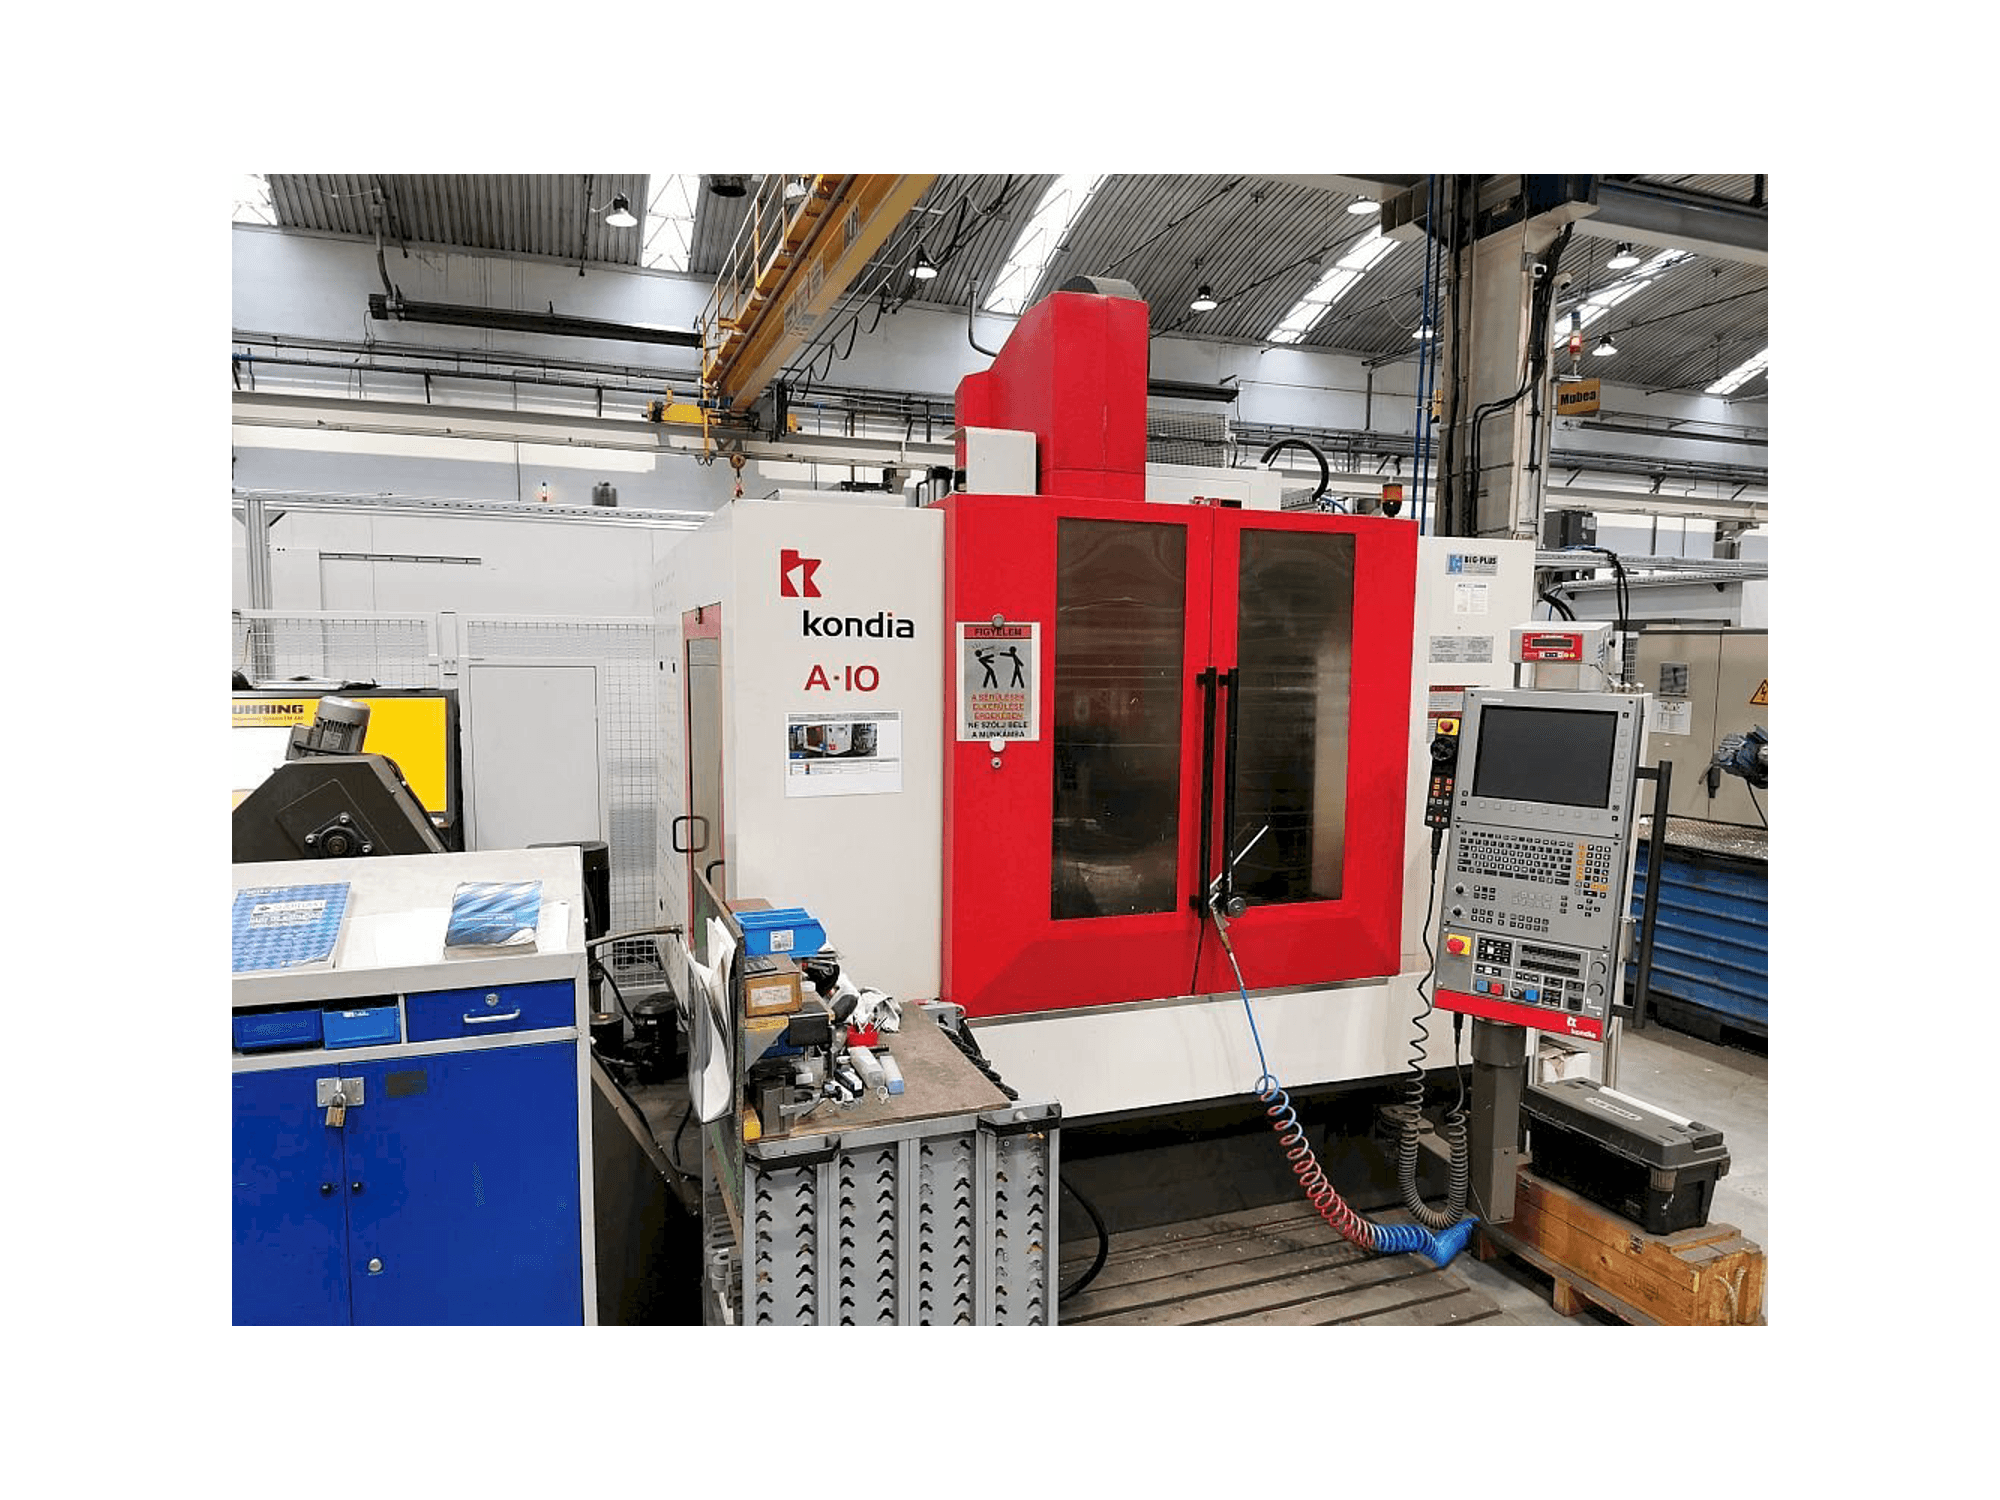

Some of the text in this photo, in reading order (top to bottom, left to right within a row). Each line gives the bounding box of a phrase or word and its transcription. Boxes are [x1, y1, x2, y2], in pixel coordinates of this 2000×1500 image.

[1560, 391, 1596, 405] Mubea
[803, 609, 914, 638] kondia
[974, 626, 1022, 637] FIGYELEM
